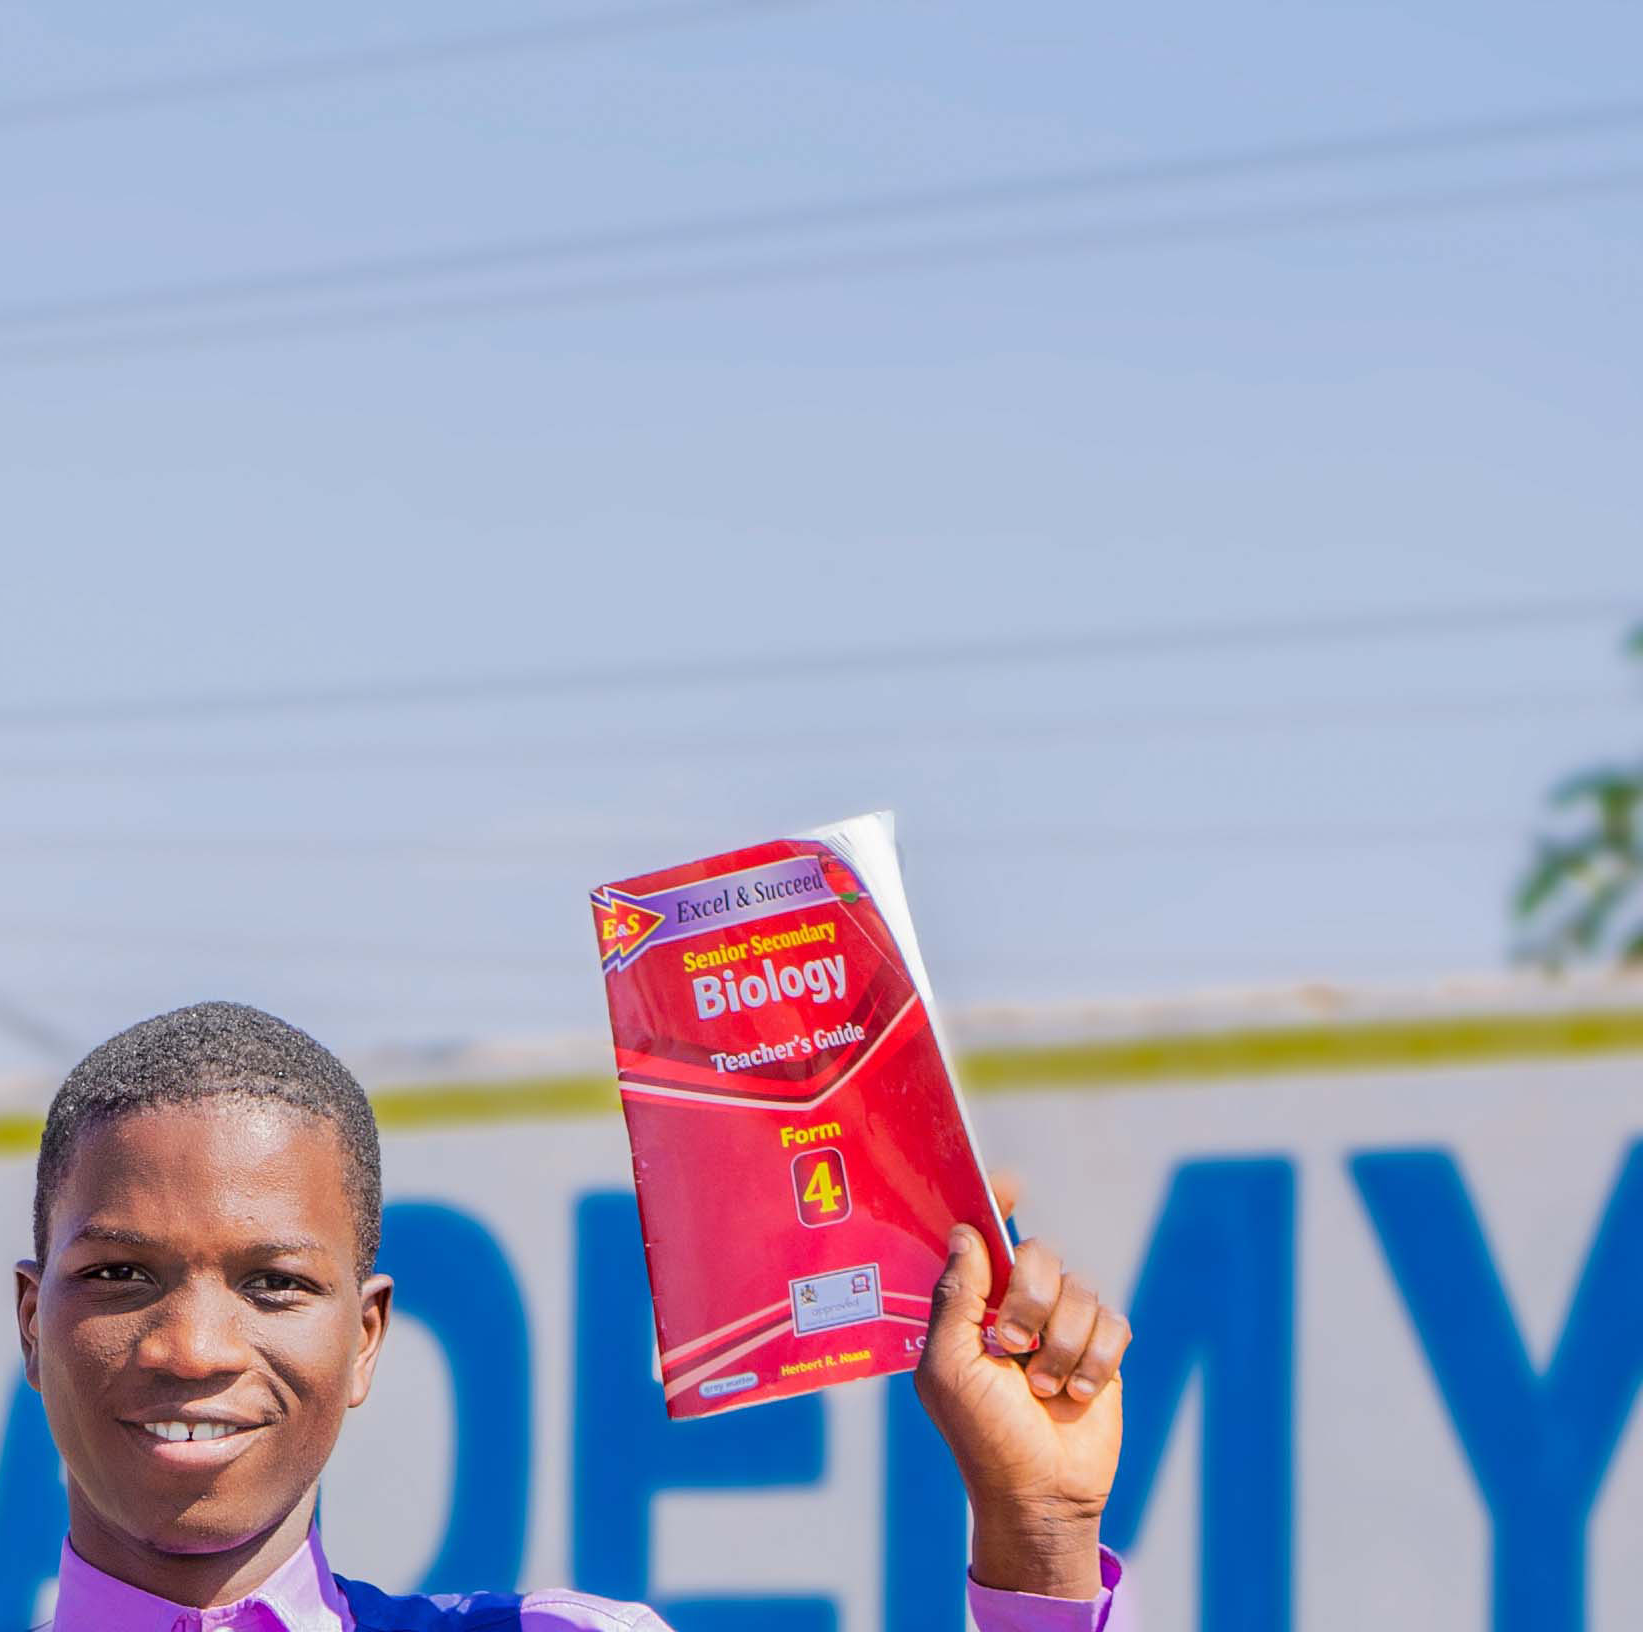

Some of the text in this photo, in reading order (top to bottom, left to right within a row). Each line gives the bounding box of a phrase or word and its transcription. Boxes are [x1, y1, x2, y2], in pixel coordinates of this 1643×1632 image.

[676, 868, 824, 924] Excel & Succeed
[602, 913, 641, 940] E&S
[682, 921, 836, 973] Senior Secondary
[691, 954, 847, 1021] Biology
[710, 1021, 866, 1073] Teacher's Guide
[780, 1120, 843, 1148] Form
[802, 1160, 843, 1214] 4
[780, 1358, 824, 1377] Herbert
[825, 1355, 838, 1368] R.
